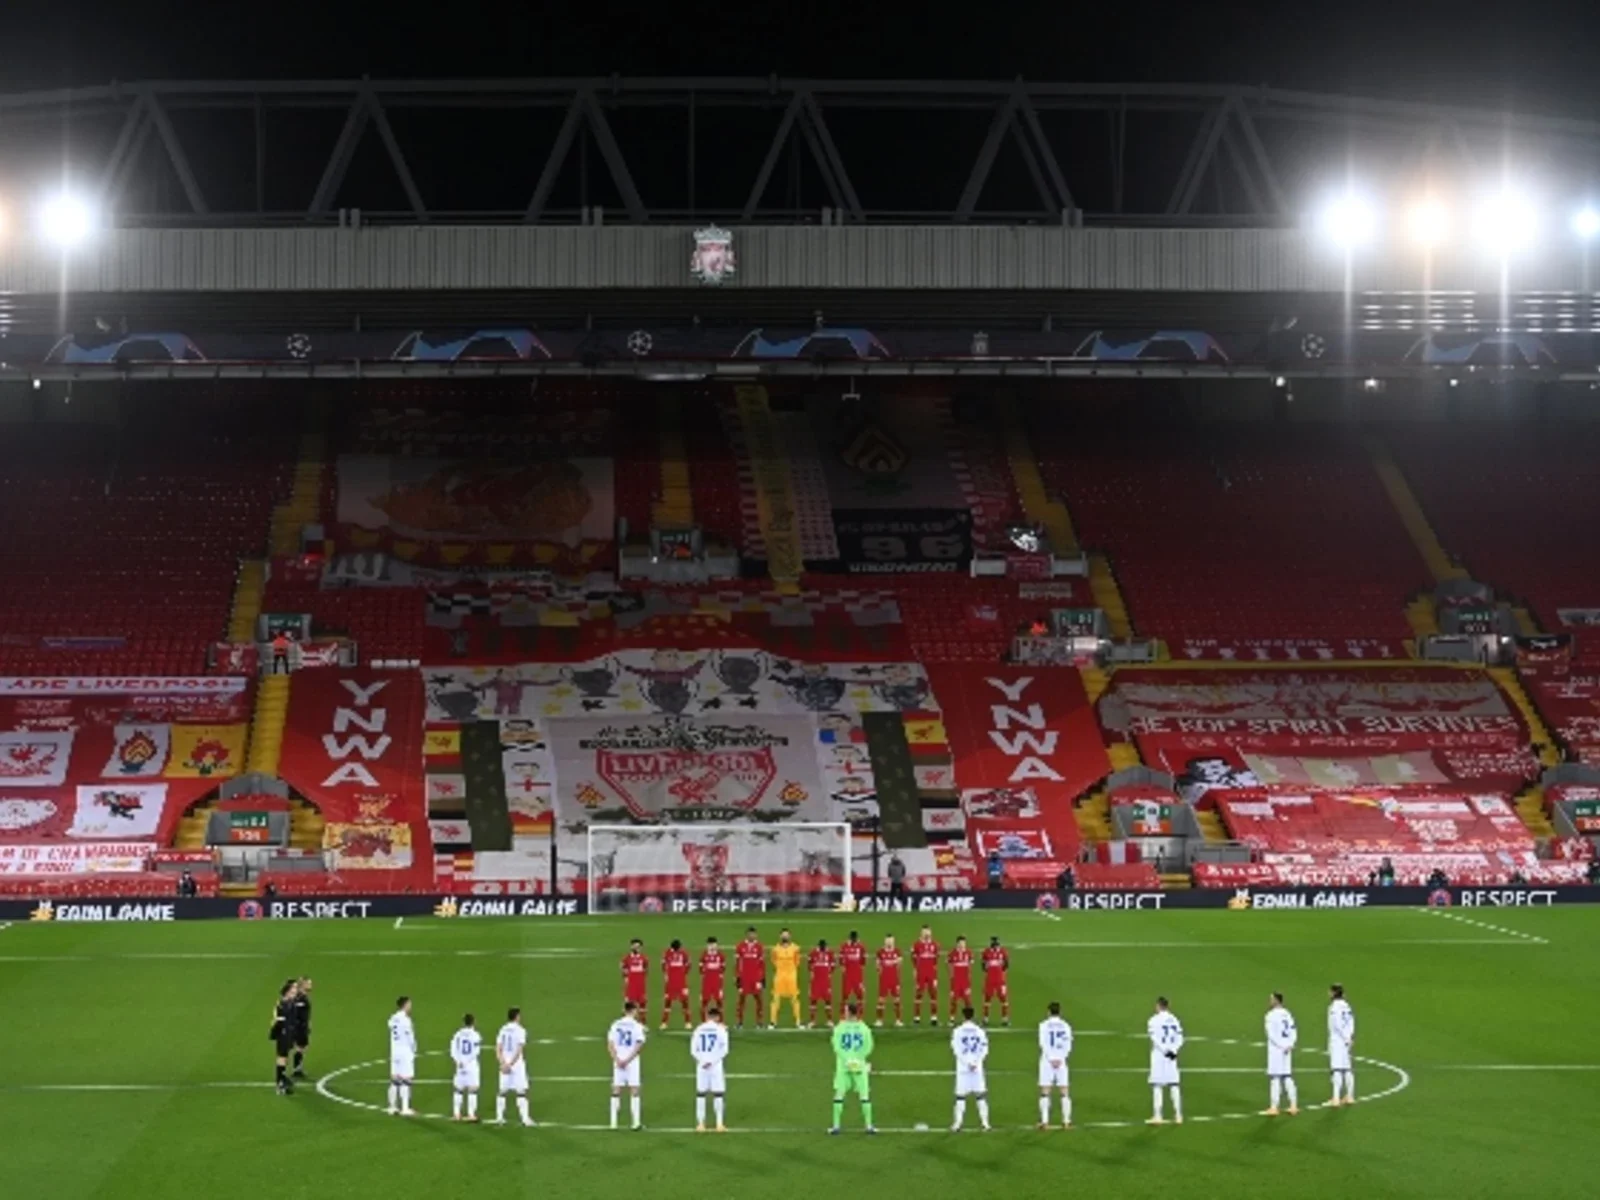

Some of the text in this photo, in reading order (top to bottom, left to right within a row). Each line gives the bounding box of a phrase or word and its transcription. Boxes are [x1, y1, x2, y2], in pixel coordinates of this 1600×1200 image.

[985, 676, 1065, 783] YNWA
[1361, 716, 1519, 732] SURVIVES
[320, 679, 393, 788] YNWA
[673, 899, 771, 913] RESPECT
[1069, 893, 1166, 909] RESPECT
[1461, 891, 1557, 907] RESPECT
[270, 902, 372, 919] RESPECT
[700, 1033, 717, 1052] 17
